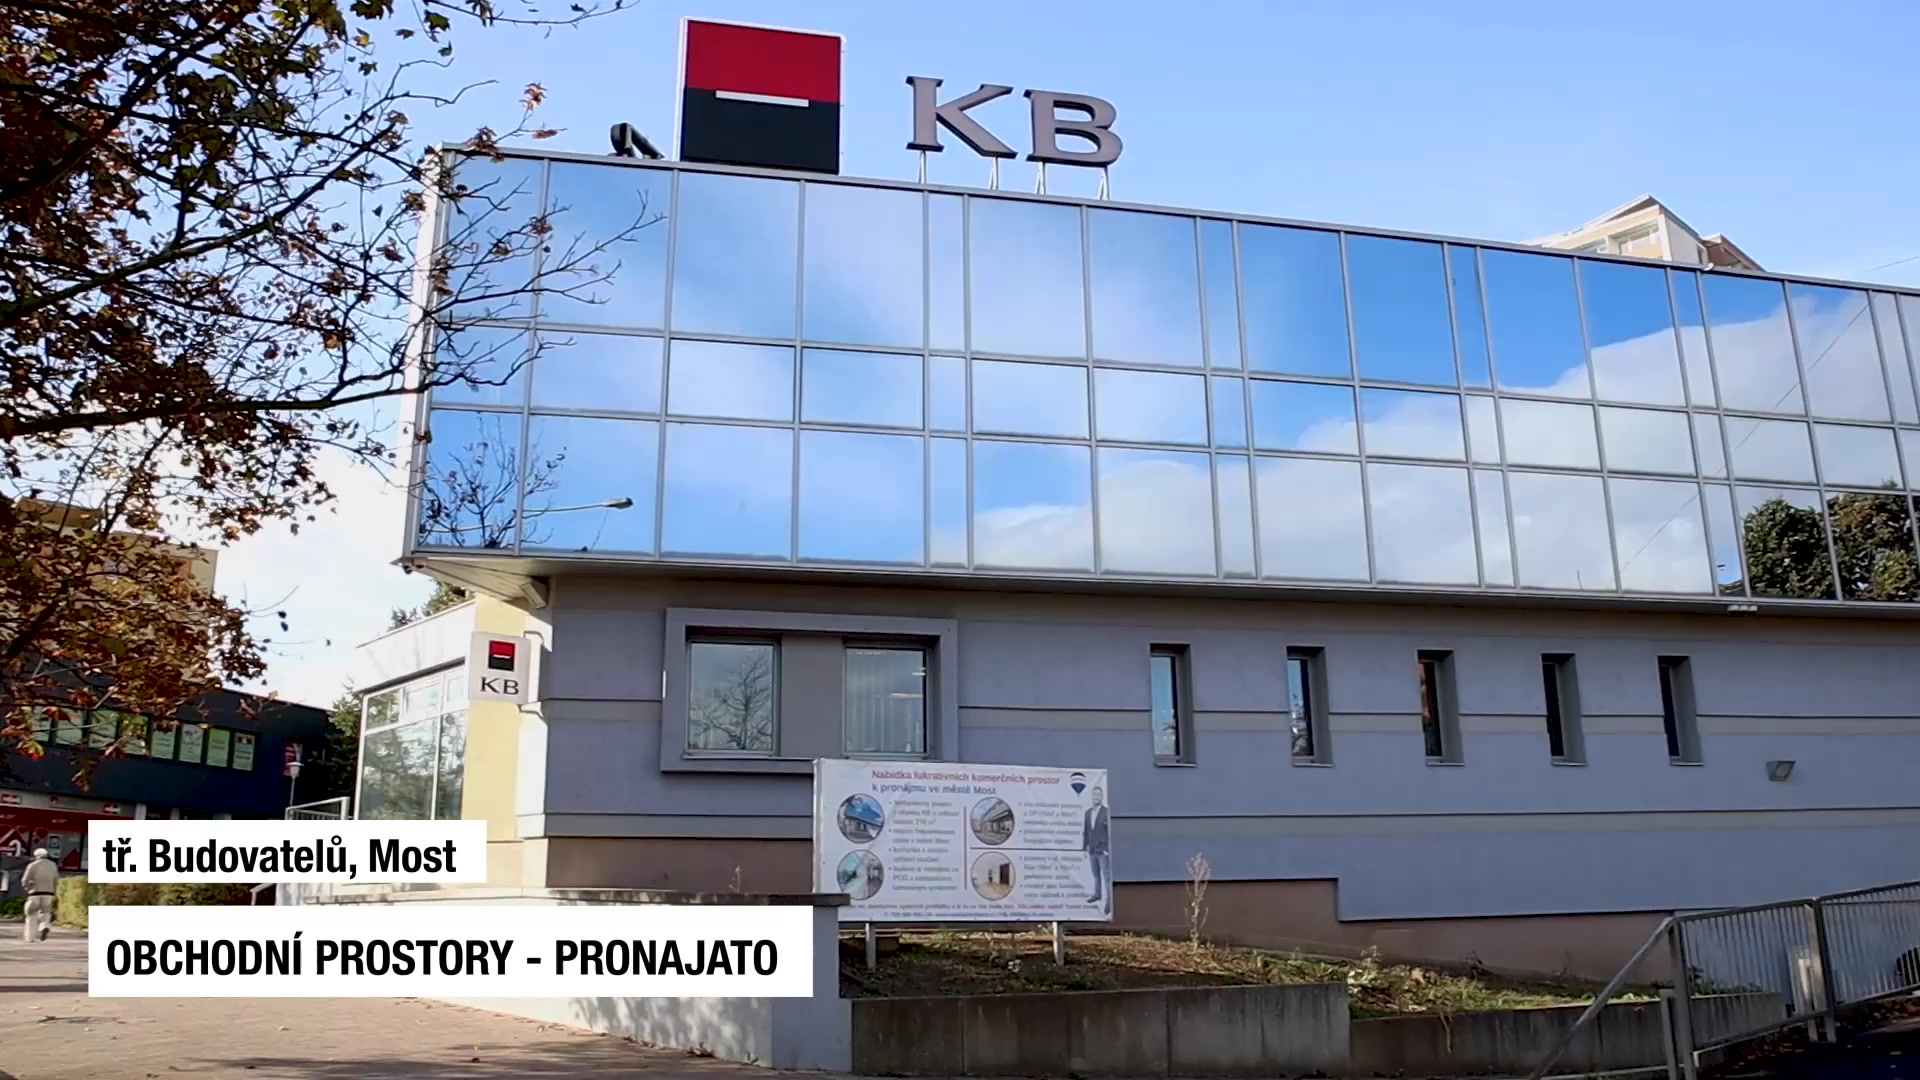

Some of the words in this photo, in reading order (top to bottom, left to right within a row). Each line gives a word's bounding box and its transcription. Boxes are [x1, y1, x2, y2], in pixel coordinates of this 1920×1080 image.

[906, 75, 1123, 167] KB
[480, 676, 519, 695] KB
[871, 769, 912, 779] Nabídka
[971, 772, 1026, 784] komerčních
[1027, 776, 1061, 787] prostor
[880, 784, 926, 794] pronájmu
[973, 785, 996, 795] Most
